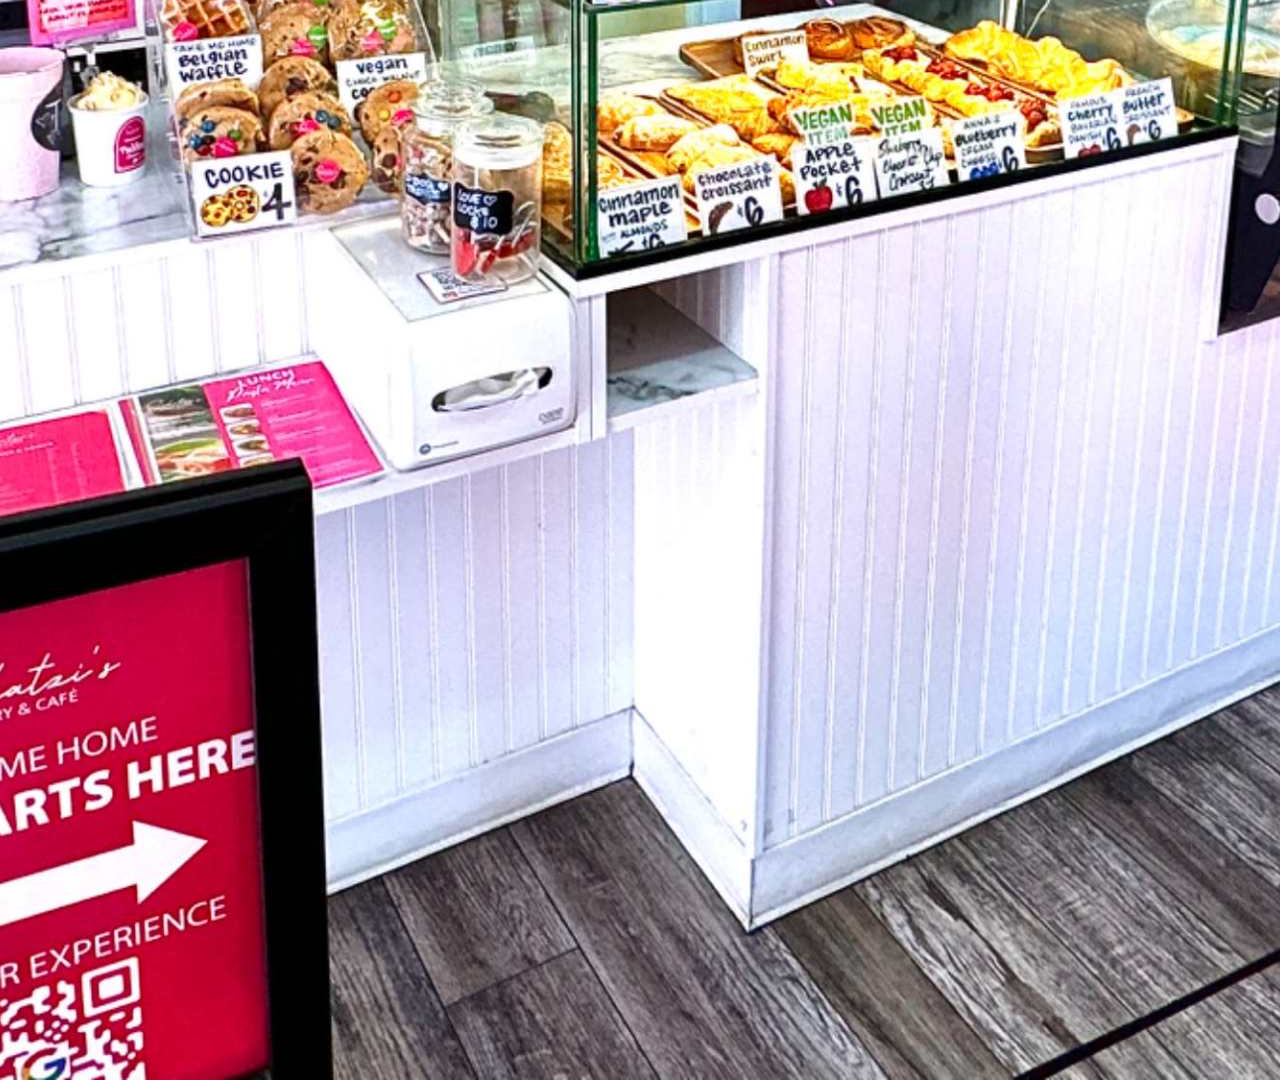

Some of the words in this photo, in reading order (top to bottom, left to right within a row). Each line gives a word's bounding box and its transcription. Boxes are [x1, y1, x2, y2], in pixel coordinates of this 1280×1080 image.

[179, 49, 248, 67] Belgian
[355, 57, 408, 75] vegan
[794, 104, 853, 131] VEGAN
[871, 98, 926, 127] VEGAN
[808, 128, 849, 146] ITEM
[806, 142, 856, 163] APPLE
[204, 162, 285, 188] COOKIE
[702, 176, 773, 201] croissant
[17, 701, 32, 716] &
[35, 687, 80, 712] CAFÉ
[56, 716, 159, 765] HOME
[127, 730, 256, 800] HERE
[29, 895, 228, 978] EXPERIENCE
